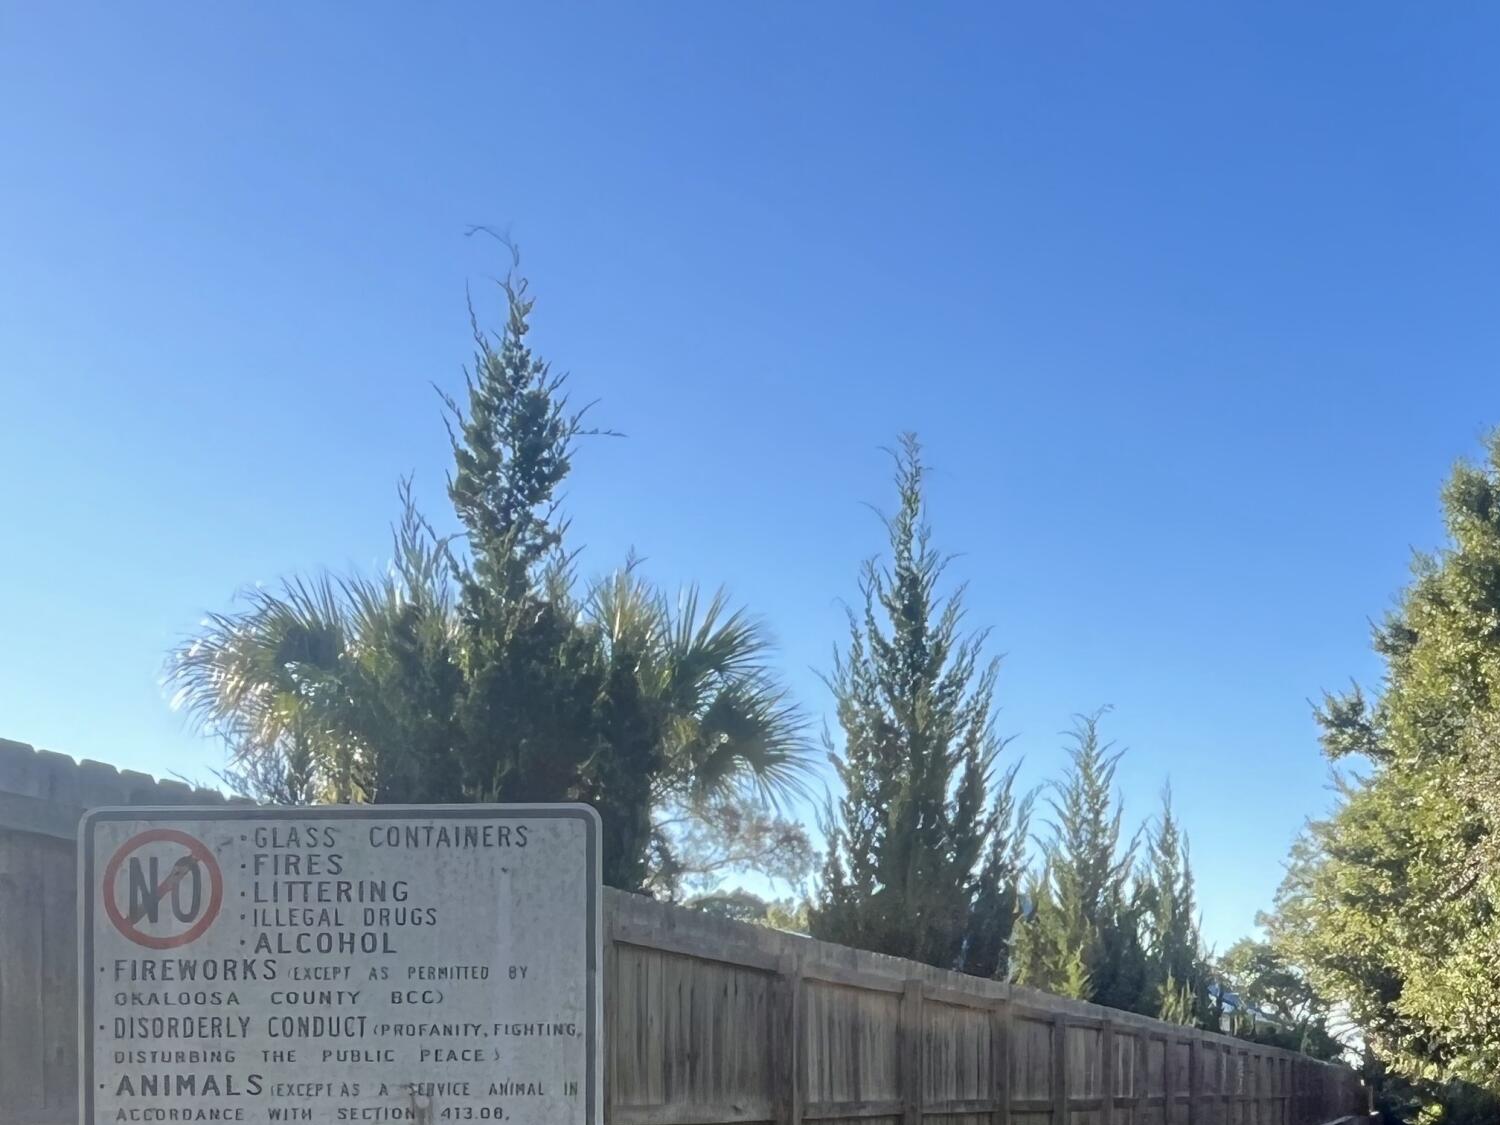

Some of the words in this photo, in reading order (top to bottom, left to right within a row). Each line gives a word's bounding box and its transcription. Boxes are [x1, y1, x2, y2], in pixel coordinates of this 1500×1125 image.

[255, 827, 337, 848] GLASS
[369, 825, 529, 848] CONTAINERS
[254, 854, 343, 876] FIRES
[129, 856, 202, 923] NO
[254, 880, 408, 903] LITTERING
[254, 907, 344, 927] ILLEGAL
[363, 907, 437, 927] DRUGS
[254, 932, 397, 954] ALCOHOL
[114, 959, 277, 981] FIREWORKS
[368, 966, 389, 980] AS
[408, 966, 489, 980] PERMITTED
[508, 966, 528, 979] BY
[114, 991, 240, 1006] OKALOOSA
[270, 991, 360, 1005] COUNTY
[391, 990, 444, 1004] BCC)
[114, 1016, 251, 1039] DISORDERLY
[268, 1016, 367, 1038] CONDUCT
[114, 1051, 236, 1064] DISTURBING
[261, 1050, 297, 1063] THE
[322, 1050, 395, 1063] PUBLIC
[116, 1074, 263, 1096] ANIMALS
[340, 1082, 360, 1096] AS
[379, 1082, 389, 1096] A
[407, 1082, 470, 1097] SERVICE
[488, 1081, 544, 1096] ANIMAL
[564, 1082, 578, 1096] IN
[116, 1107, 244, 1121] ACCORDANCE
[267, 1107, 312, 1121] WITH
[337, 1107, 415, 1120] SECTION
